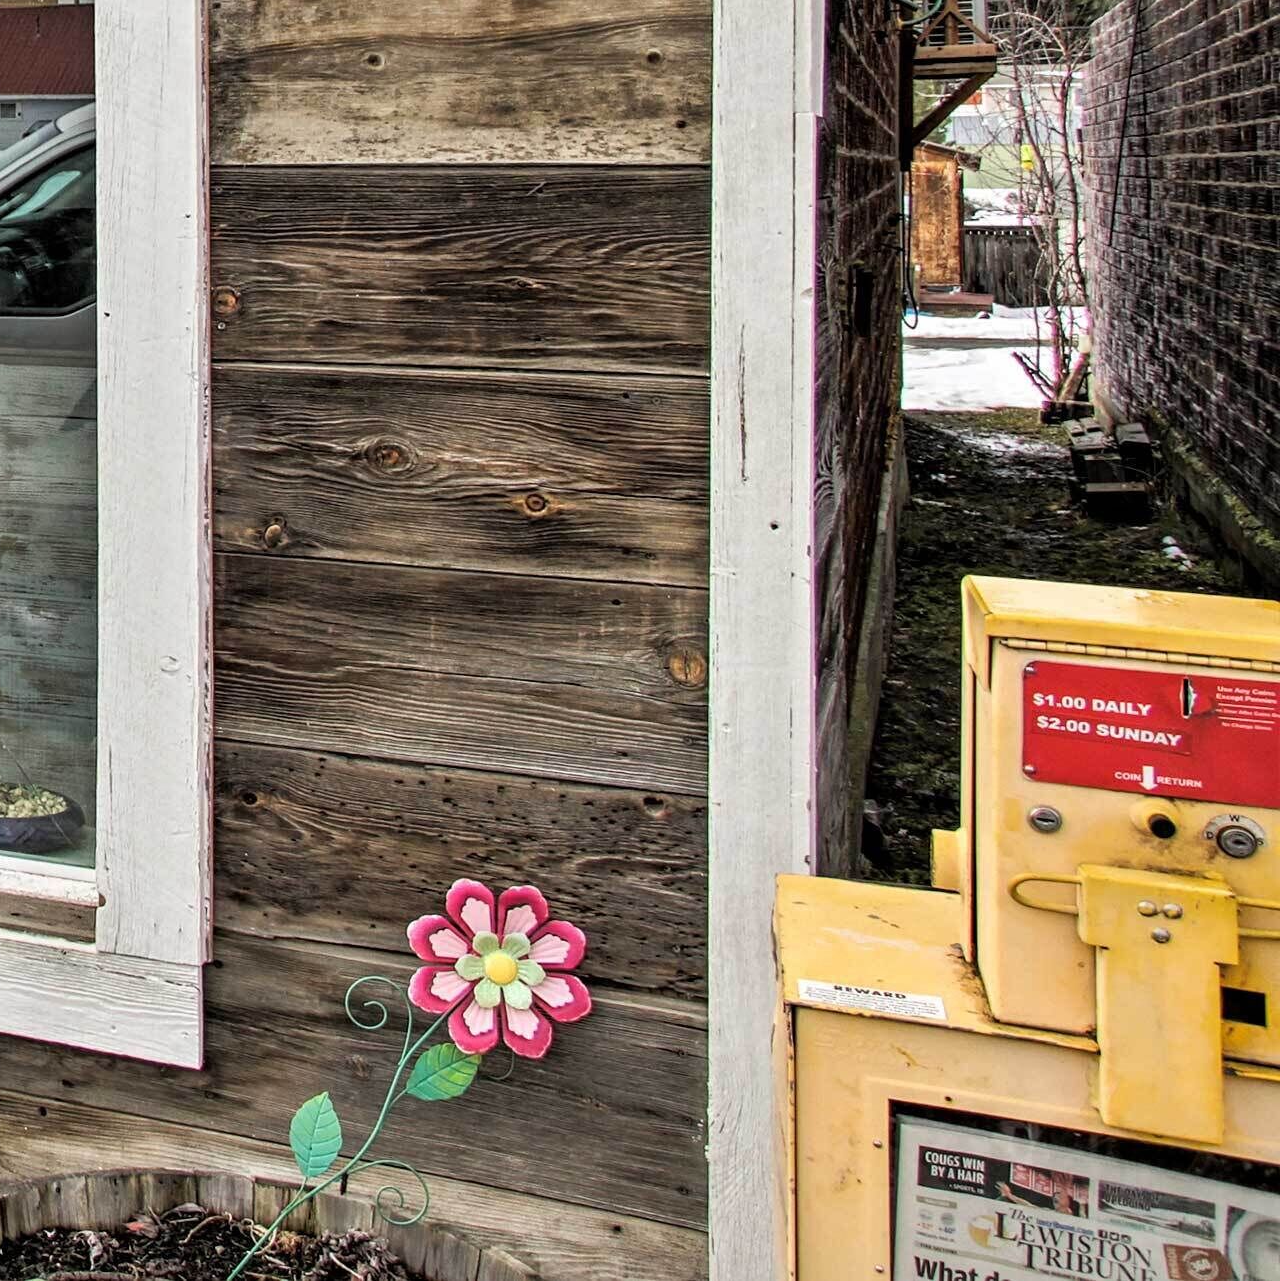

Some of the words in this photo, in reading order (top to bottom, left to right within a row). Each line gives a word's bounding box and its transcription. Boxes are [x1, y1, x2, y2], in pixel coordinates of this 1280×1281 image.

[1033, 692, 1085, 710] $1.00
[1092, 698, 1151, 716] DAILY
[1036, 715, 1090, 734] $2.00
[1096, 722, 1182, 747] SUNDAY
[1114, 771, 1141, 782] COIN
[1157, 775, 1202, 789] RETURN
[834, 984, 907, 1000] REWARD
[925, 1151, 960, 1167] COUGS
[962, 1156, 985, 1172] WIN
[931, 1164, 945, 1178] BY
[947, 1167, 956, 1179] A
[957, 1169, 985, 1185] HAIR
[1010, 1207, 1033, 1222] The
[994, 1210, 1153, 1268] LEWISTON
[914, 1255, 978, 1281] What
[1016, 1241, 1158, 1281] TRIBUNE
